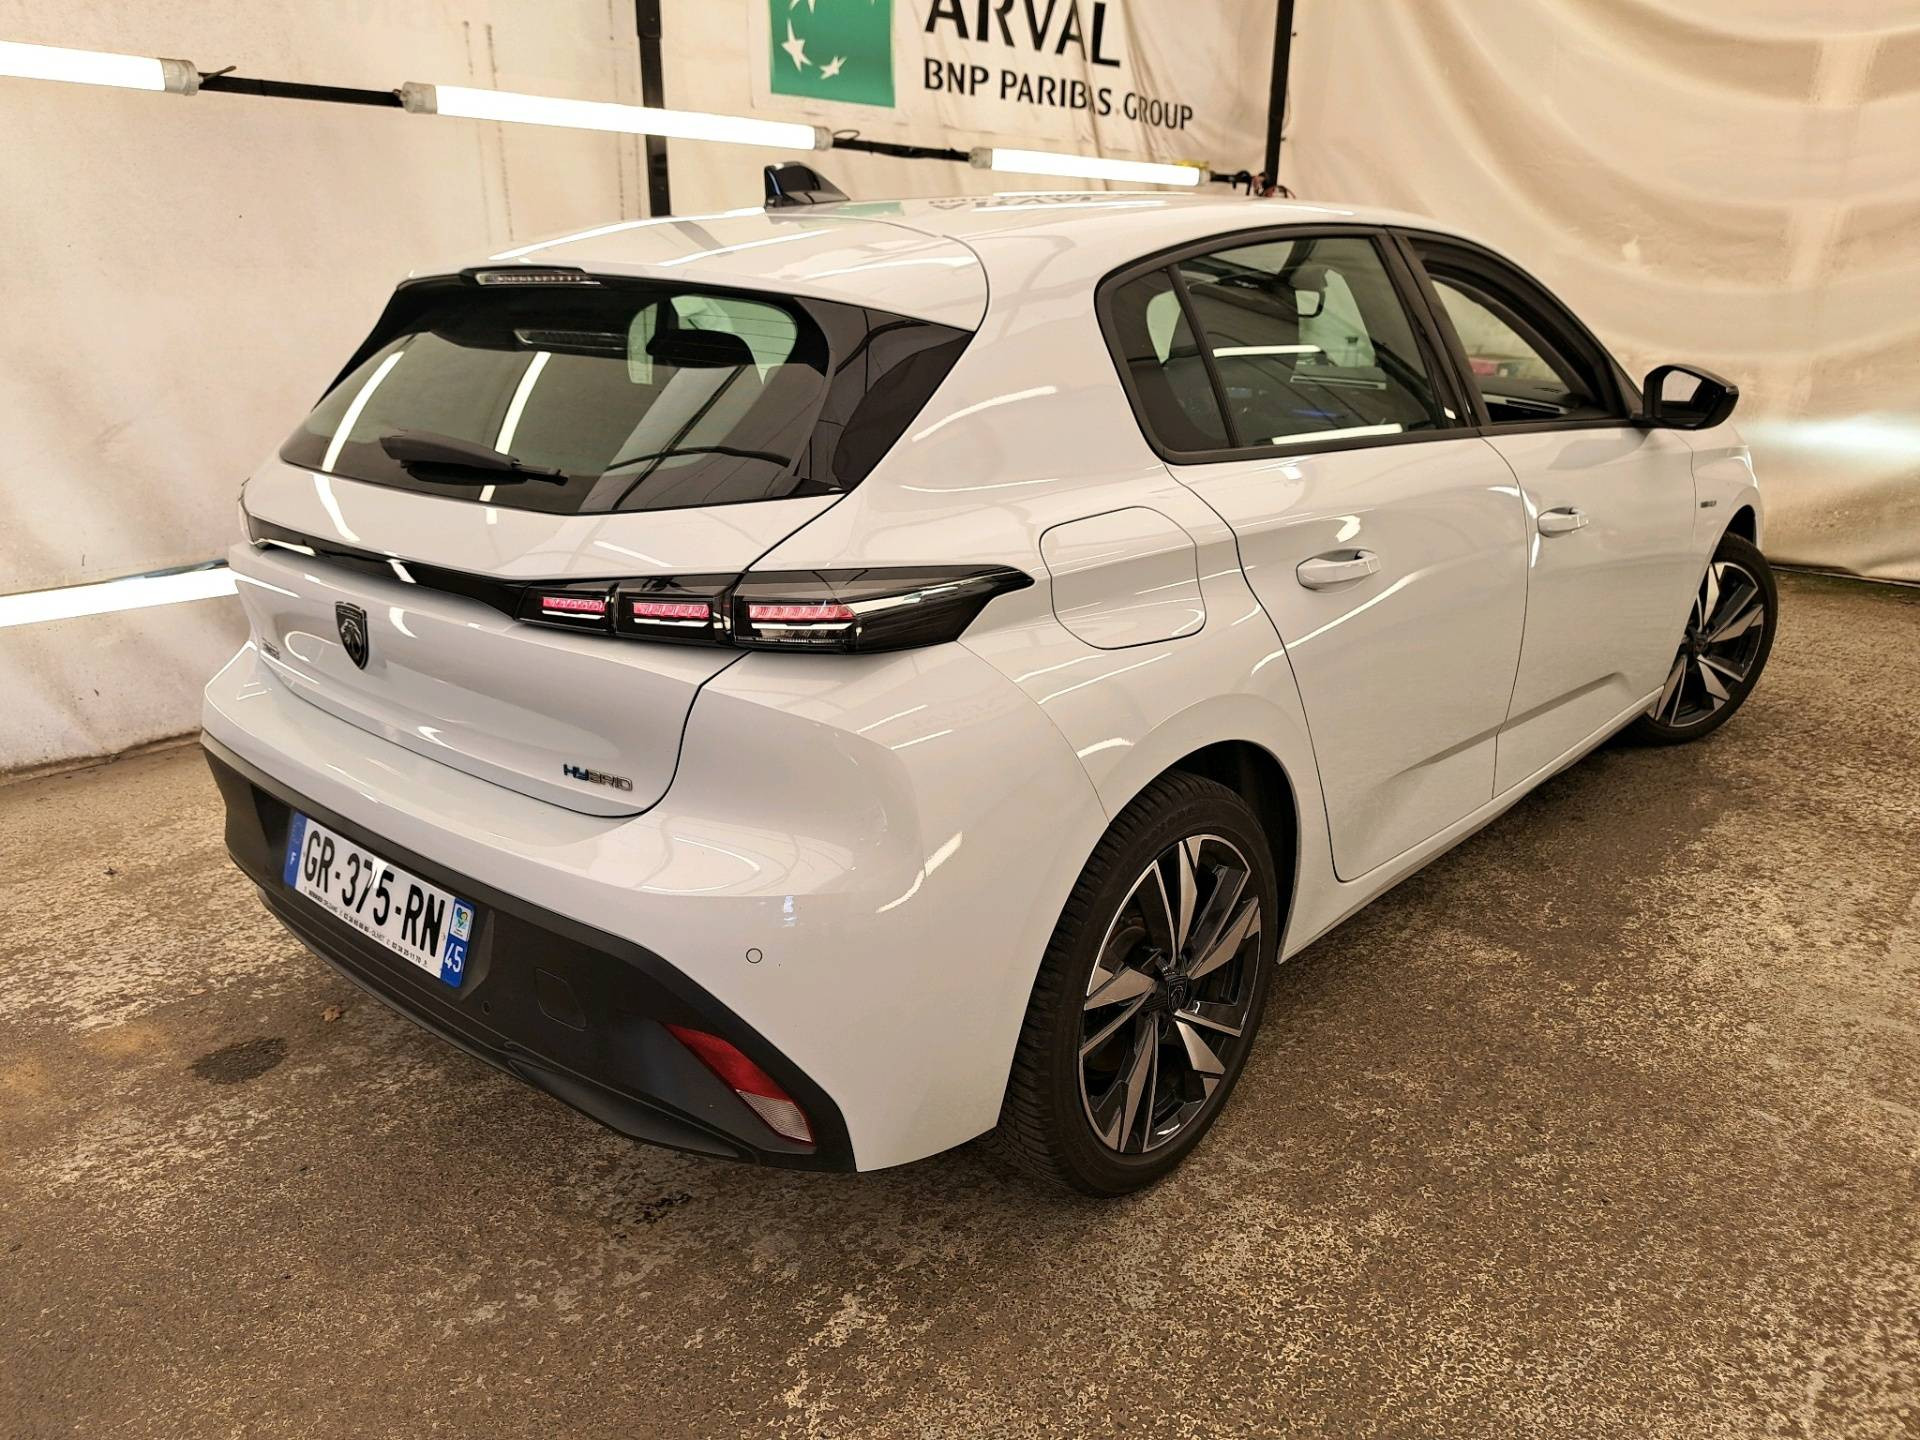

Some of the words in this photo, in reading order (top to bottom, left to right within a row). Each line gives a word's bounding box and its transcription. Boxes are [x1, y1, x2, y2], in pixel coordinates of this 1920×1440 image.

[925, 0, 1121, 68] ARVAL
[924, 57, 989, 96] BNP
[1123, 92, 1193, 130] GROUP
[563, 763, 633, 792] HYBRID
[304, 830, 446, 958] GR-375-RN
[444, 942, 464, 973] 45
